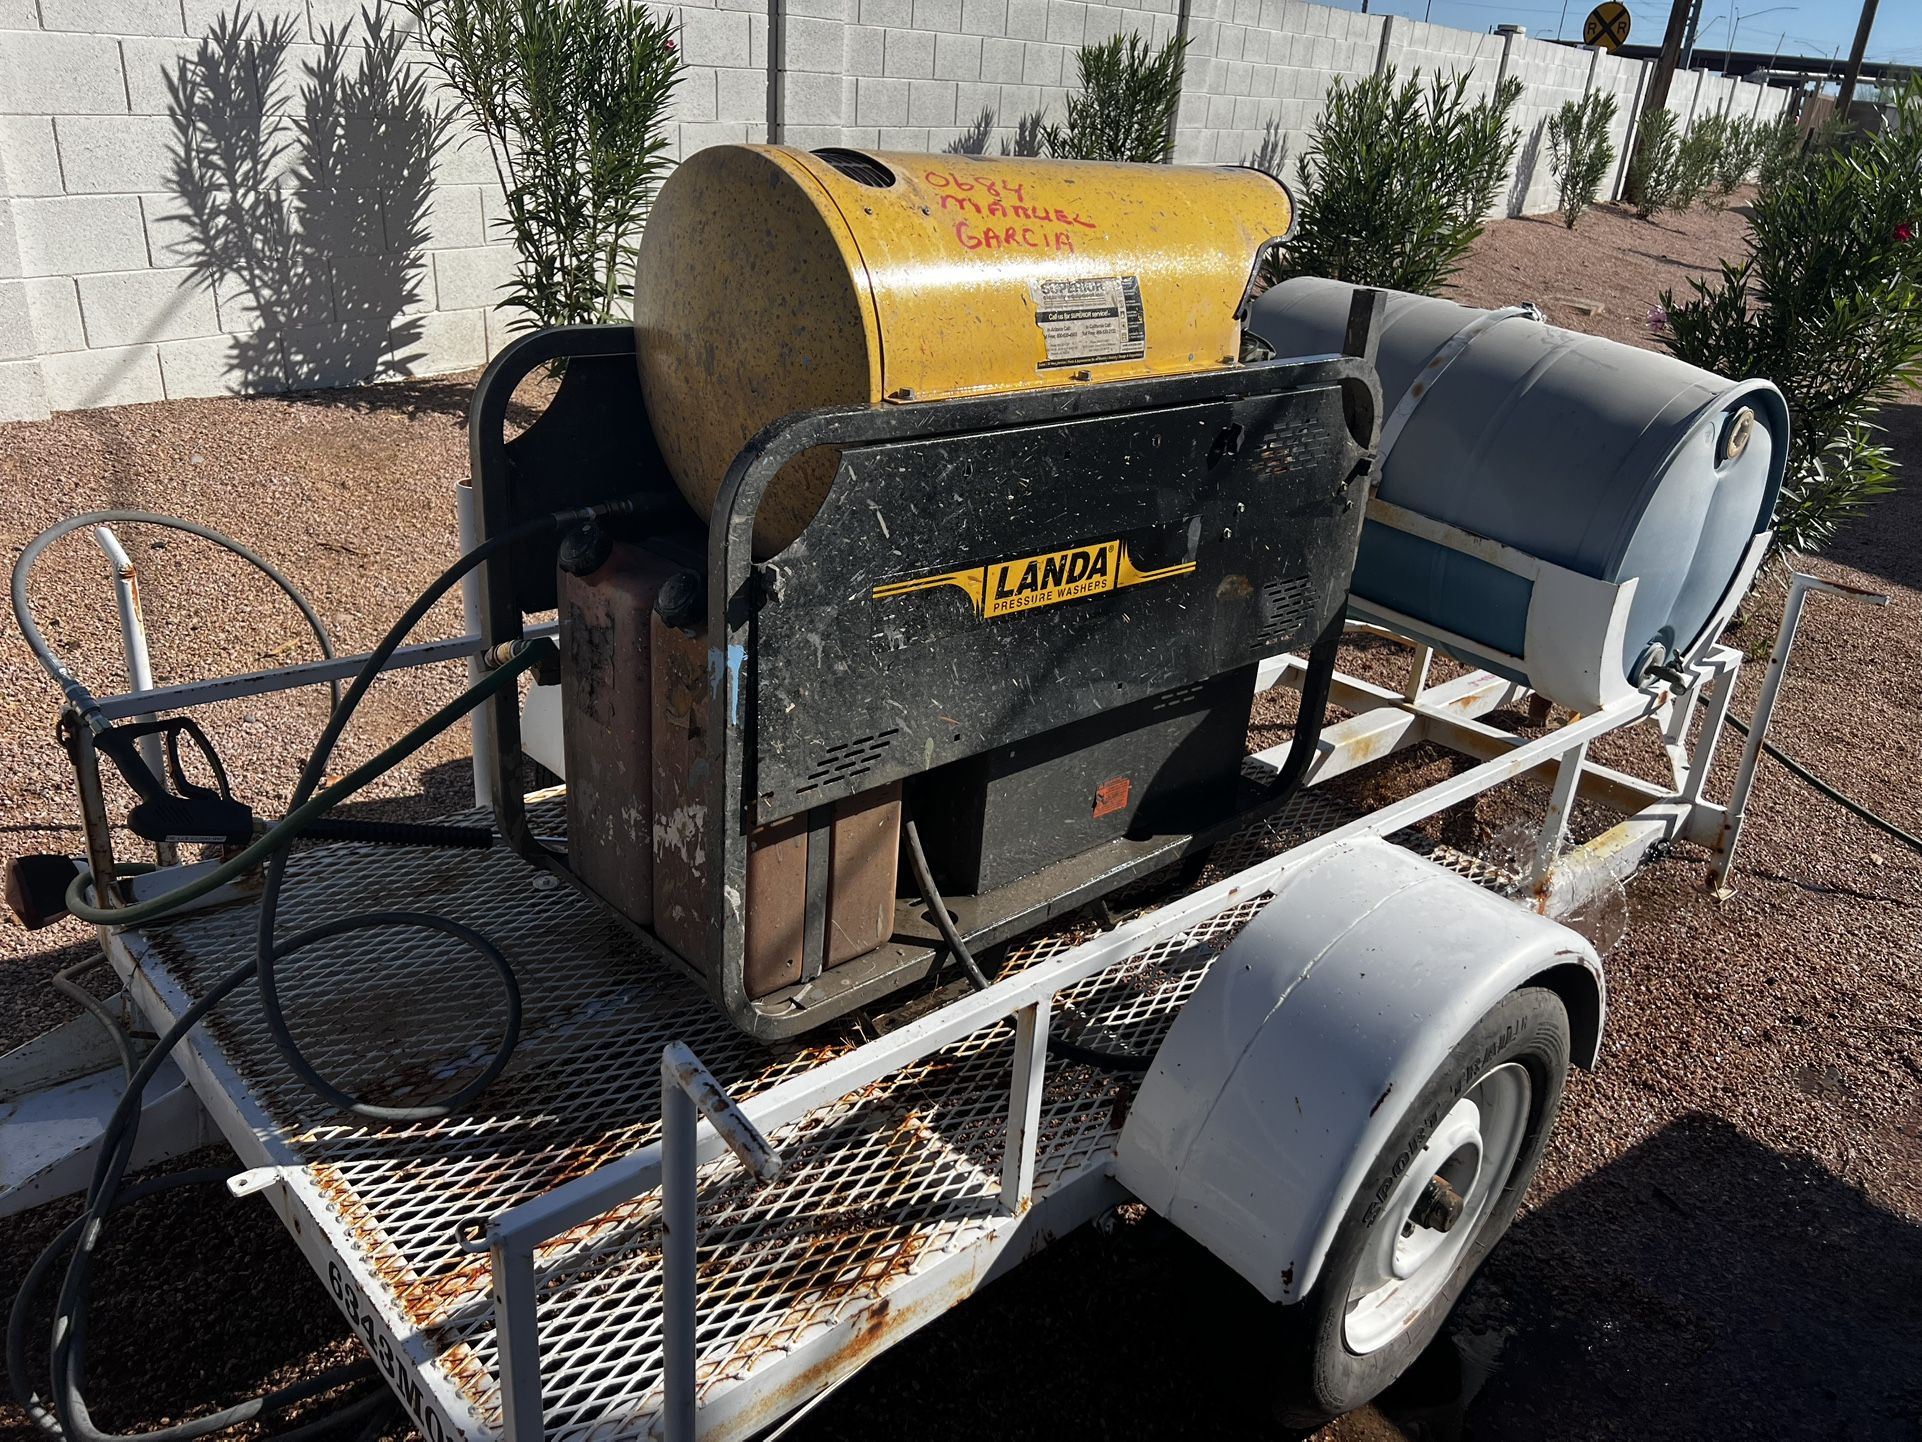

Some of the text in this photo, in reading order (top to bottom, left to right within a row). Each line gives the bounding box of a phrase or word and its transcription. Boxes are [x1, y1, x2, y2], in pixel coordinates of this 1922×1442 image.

[1587, 21, 1627, 35] R R
[925, 171, 1024, 202] 0684
[940, 194, 1097, 228] MANUEL
[955, 221, 1074, 254] GARCIA
[1041, 280, 1105, 294] SUPERIOR
[994, 546, 1108, 600] LANDA
[993, 579, 1107, 612] PRESSURE WASHERS
[1362, 1102, 1441, 1229] SPORT
